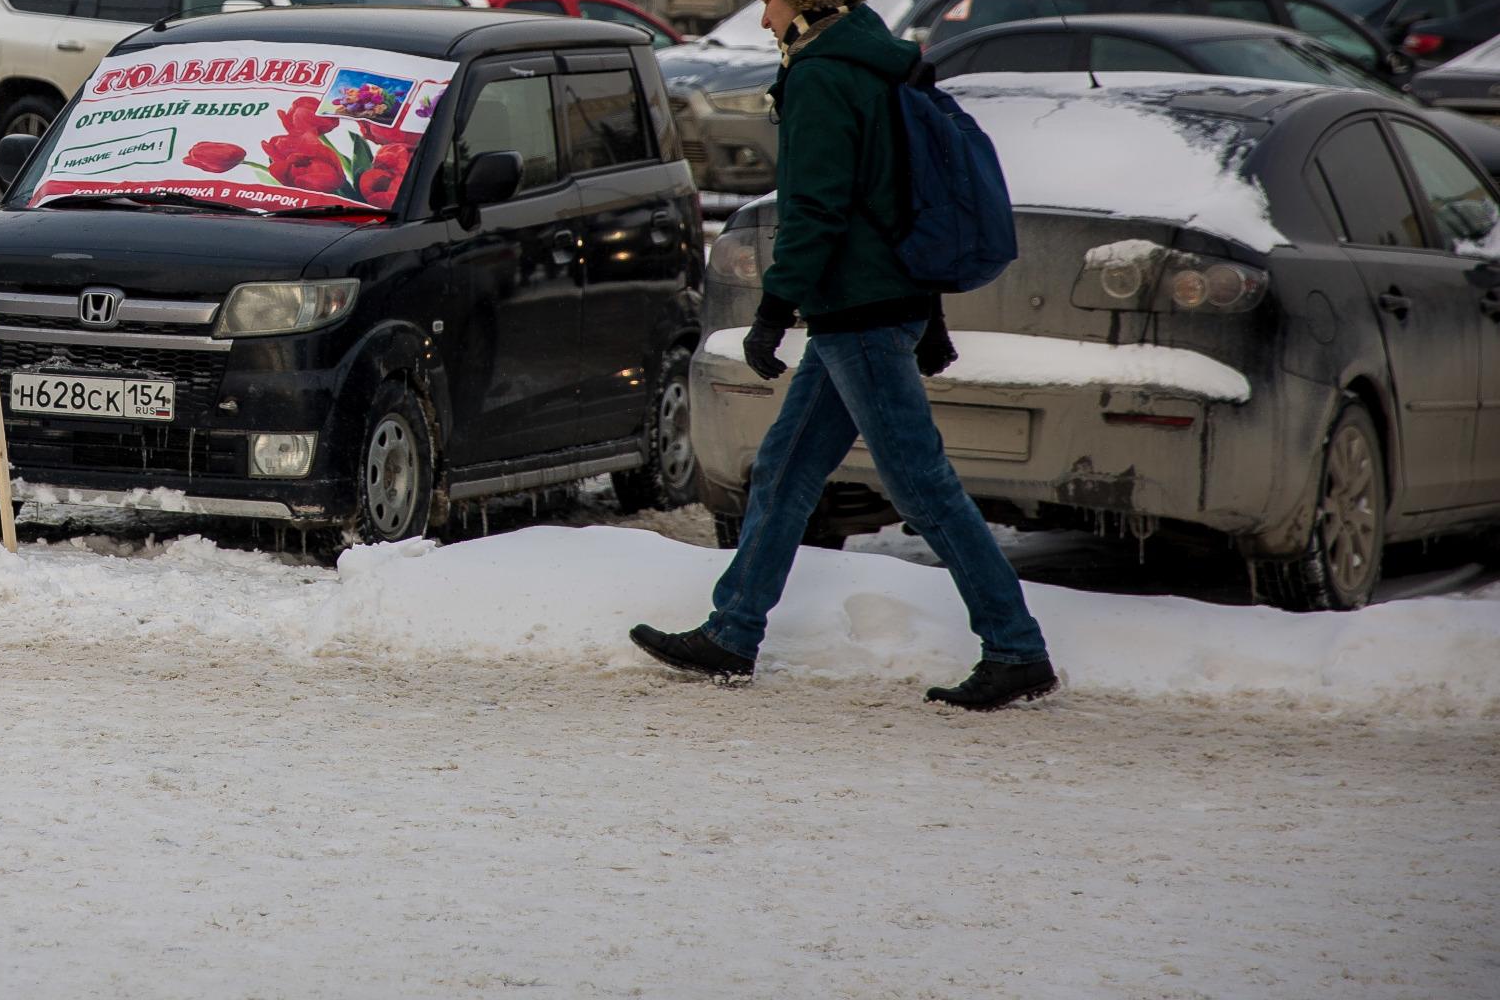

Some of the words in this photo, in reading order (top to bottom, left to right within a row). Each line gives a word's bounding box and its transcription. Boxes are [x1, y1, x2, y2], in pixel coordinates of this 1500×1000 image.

[93, 57, 334, 94] ТЮЛЬПАНЫ
[76, 100, 192, 129] ОГРОМНЫЙ
[192, 102, 270, 120] ВЫБОР
[64, 152, 112, 168] НИЗКИЕ
[221, 187, 231, 197] В
[127, 384, 167, 407] 154
[135, 406, 156, 415] RUS
